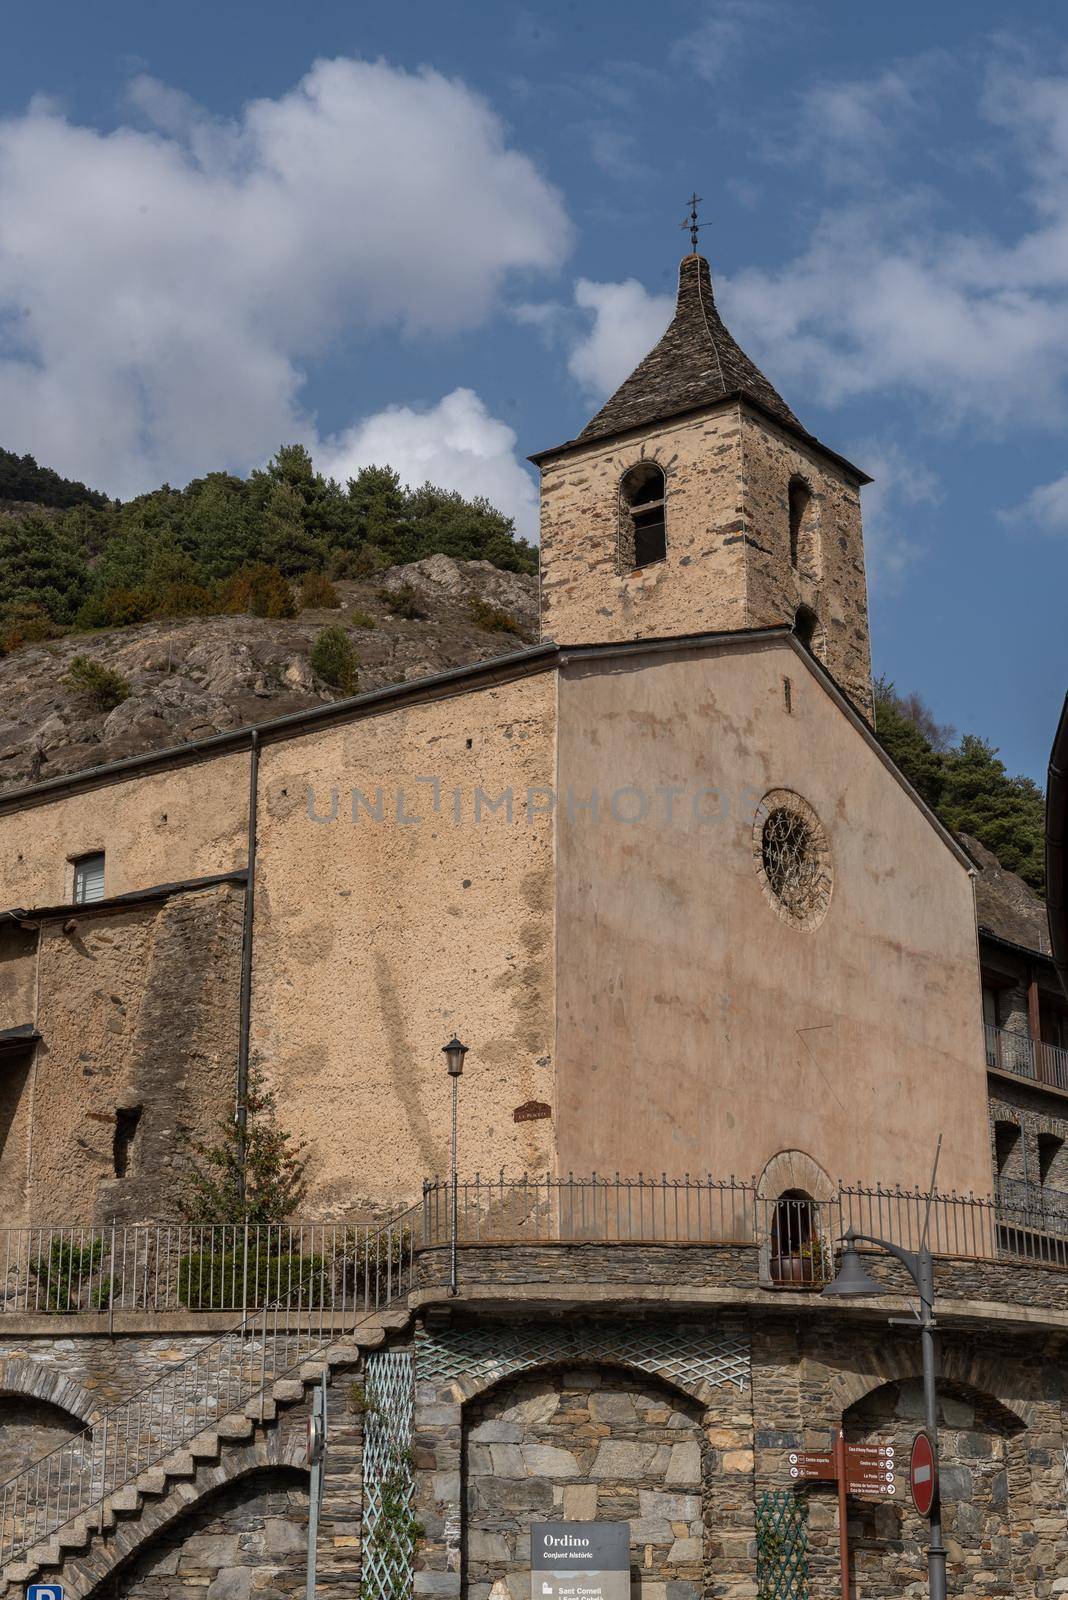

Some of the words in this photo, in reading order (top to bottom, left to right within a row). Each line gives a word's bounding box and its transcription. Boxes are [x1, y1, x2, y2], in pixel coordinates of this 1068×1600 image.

[543, 1534, 590, 1547] Ordino
[543, 1551, 568, 1560] Conjunt
[568, 1551, 593, 1559] històric
[558, 1587, 575, 1595] Sant
